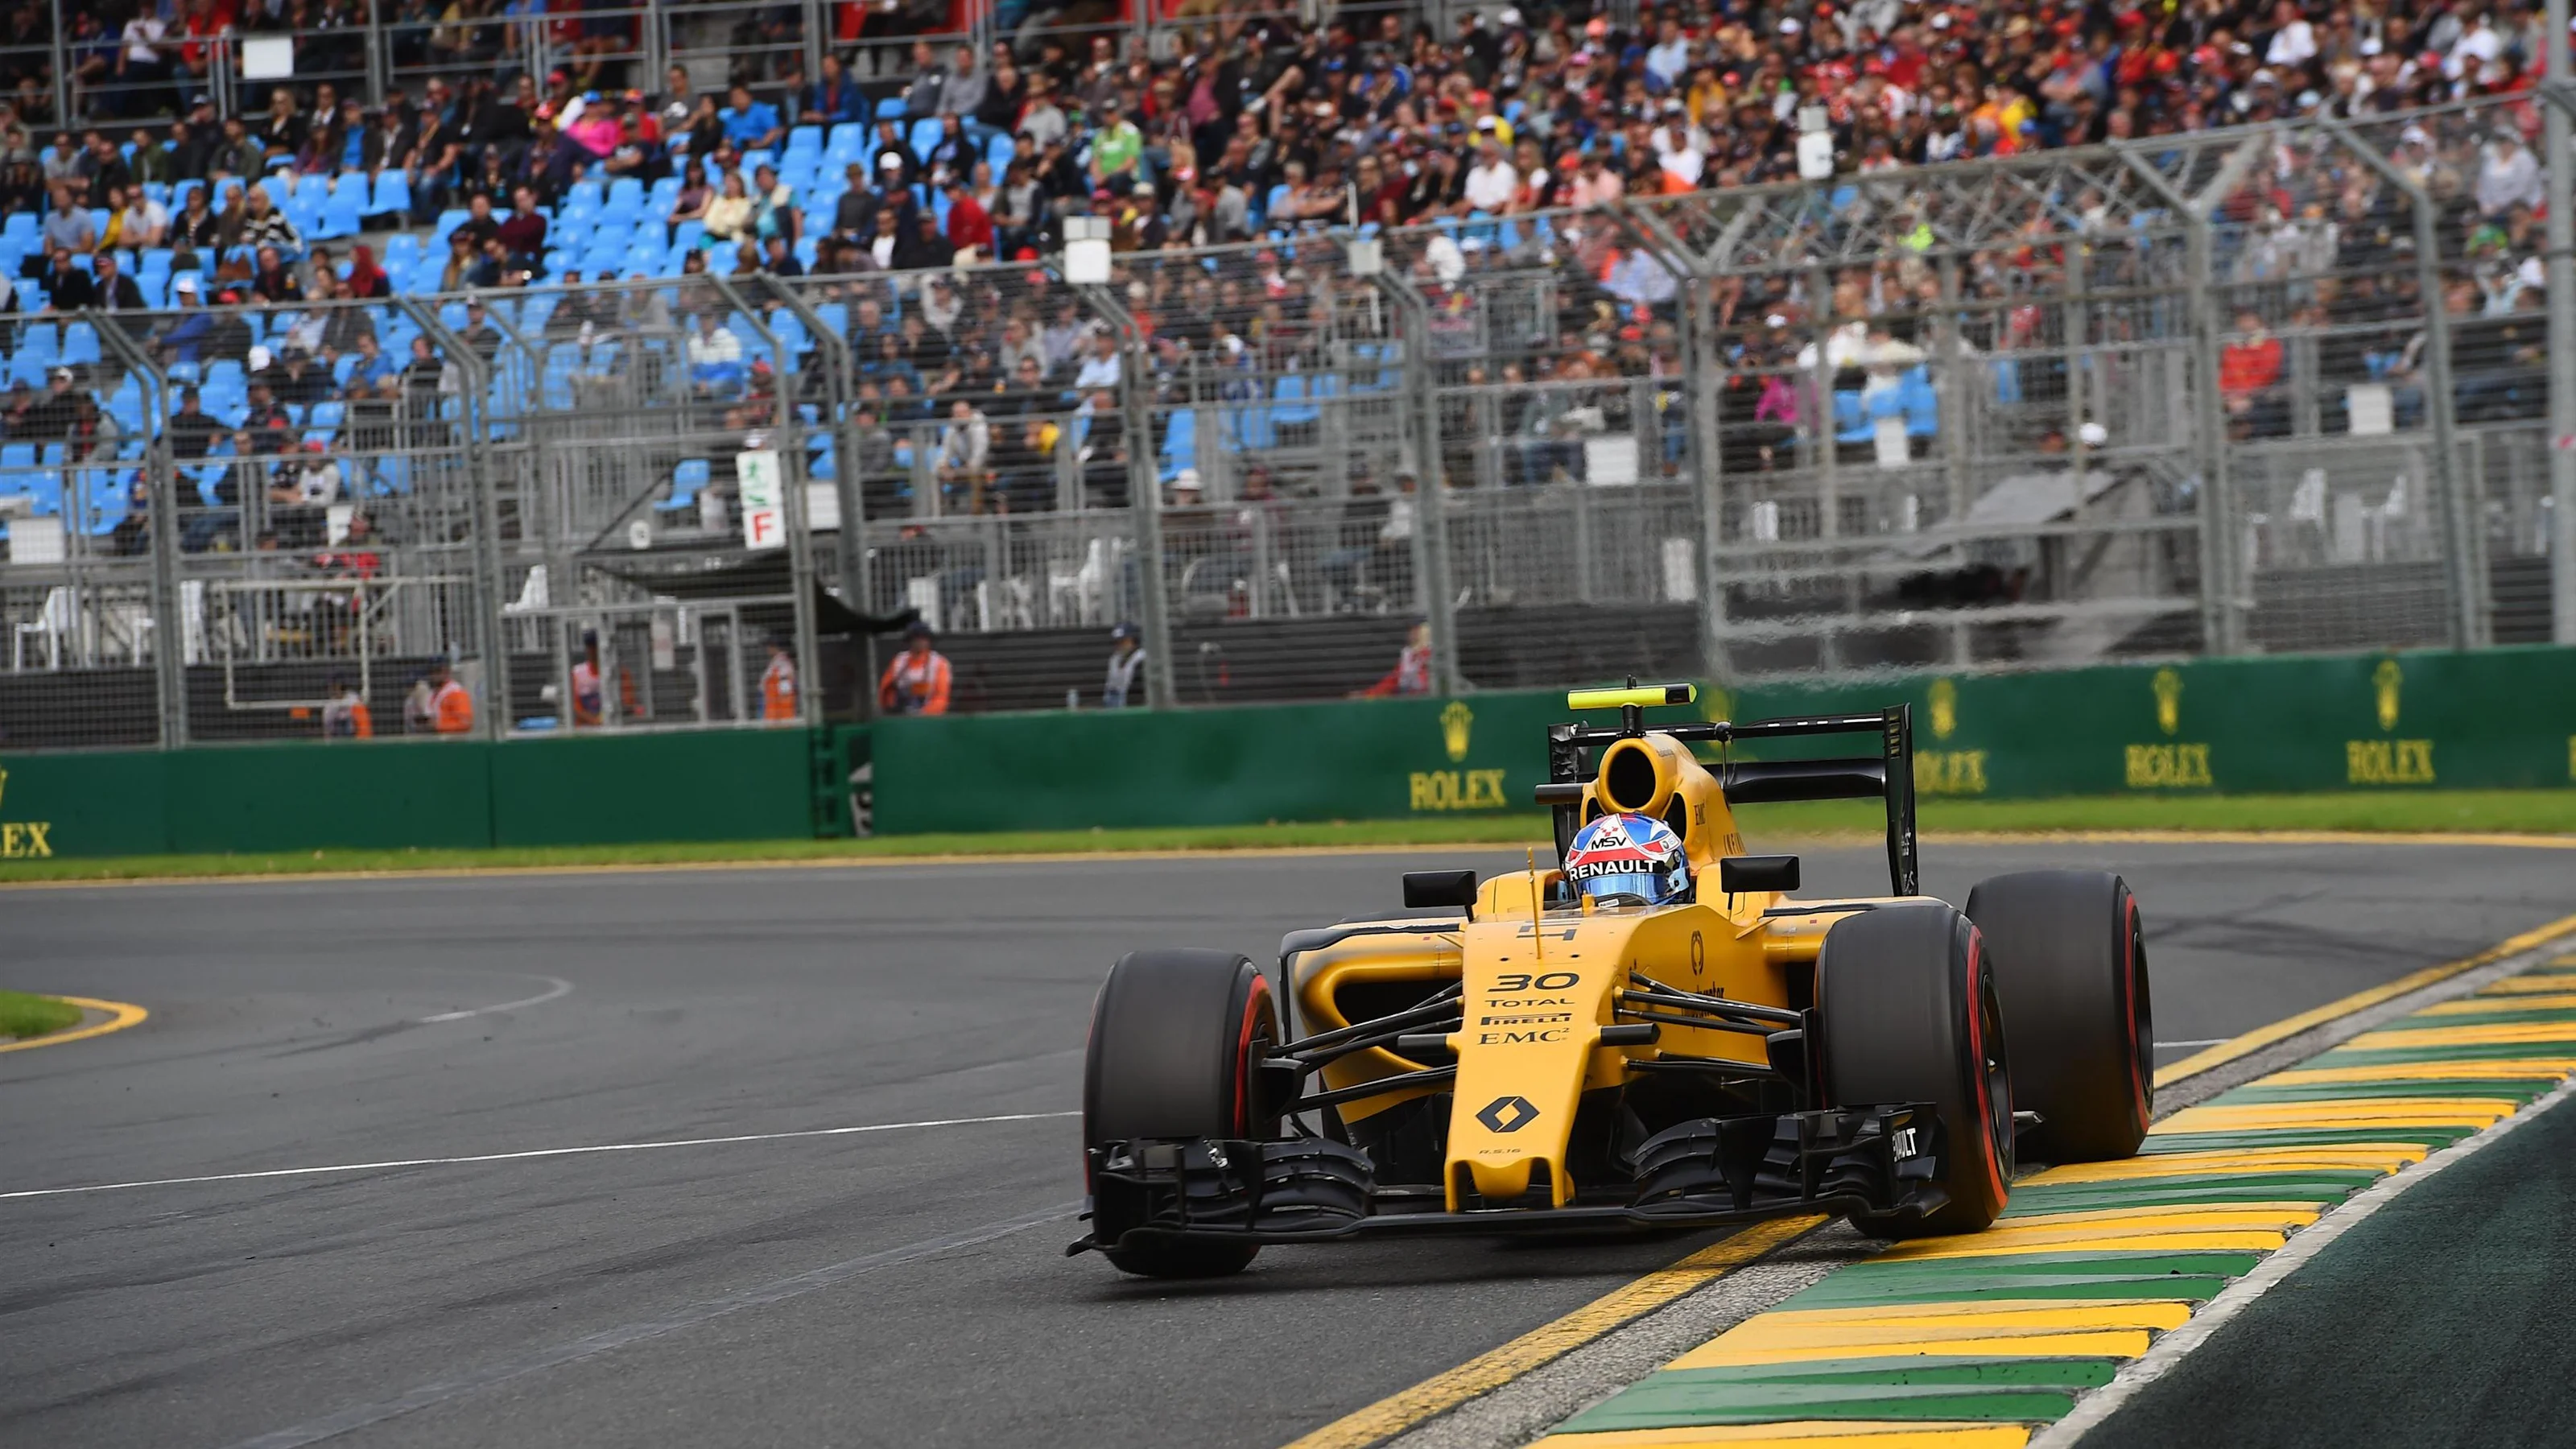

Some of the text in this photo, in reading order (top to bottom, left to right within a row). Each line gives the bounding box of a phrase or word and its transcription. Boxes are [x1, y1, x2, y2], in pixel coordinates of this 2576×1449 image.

[753, 512, 773, 543] F
[2346, 739, 2436, 783] ROLEX
[1409, 769, 1508, 811] ROLEX
[1591, 836, 1627, 851] MSV
[1570, 860, 1657, 882] RENAULT
[1487, 972, 1580, 993] 30
[1485, 998, 1575, 1008] TOTAL
[1480, 1013, 1573, 1026] PIRELLI
